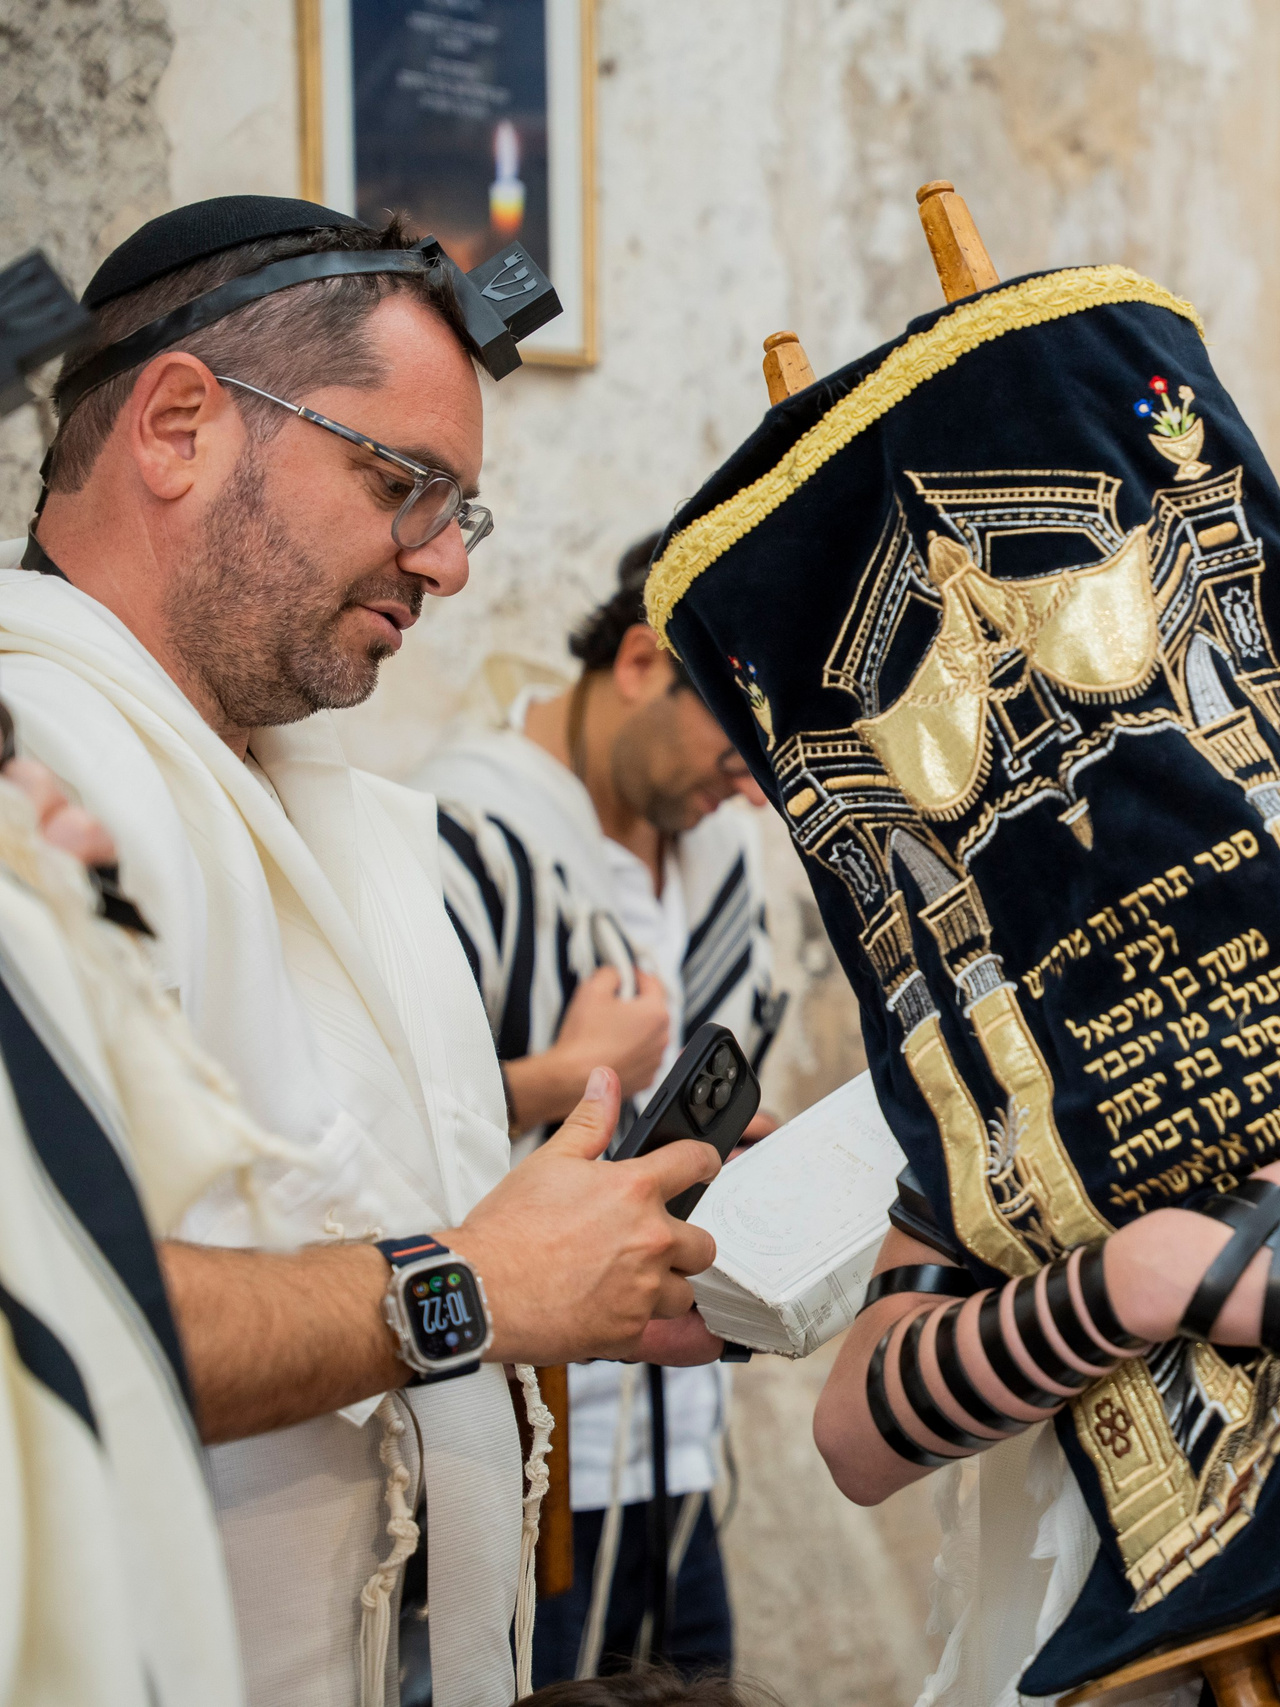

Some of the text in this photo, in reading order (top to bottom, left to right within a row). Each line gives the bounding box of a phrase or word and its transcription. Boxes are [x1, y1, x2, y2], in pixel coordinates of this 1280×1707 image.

[480, 251, 538, 302] ש
[1194, 829, 1260, 873] ספר
[1120, 864, 1194, 924] תורה
[1087, 906, 1124, 944] זה
[1064, 927, 1270, 1051] משה בן מיכאל
[1083, 1030, 1164, 1082] יוכבד
[1166, 1011, 1210, 1052] מן
[1173, 1047, 1223, 1091] בת
[1096, 1071, 1168, 1141] יצחק
[1197, 1087, 1242, 1134] מן
[1109, 1106, 1200, 1174] דבורה
[417, 1290, 472, 1335] 10:22
